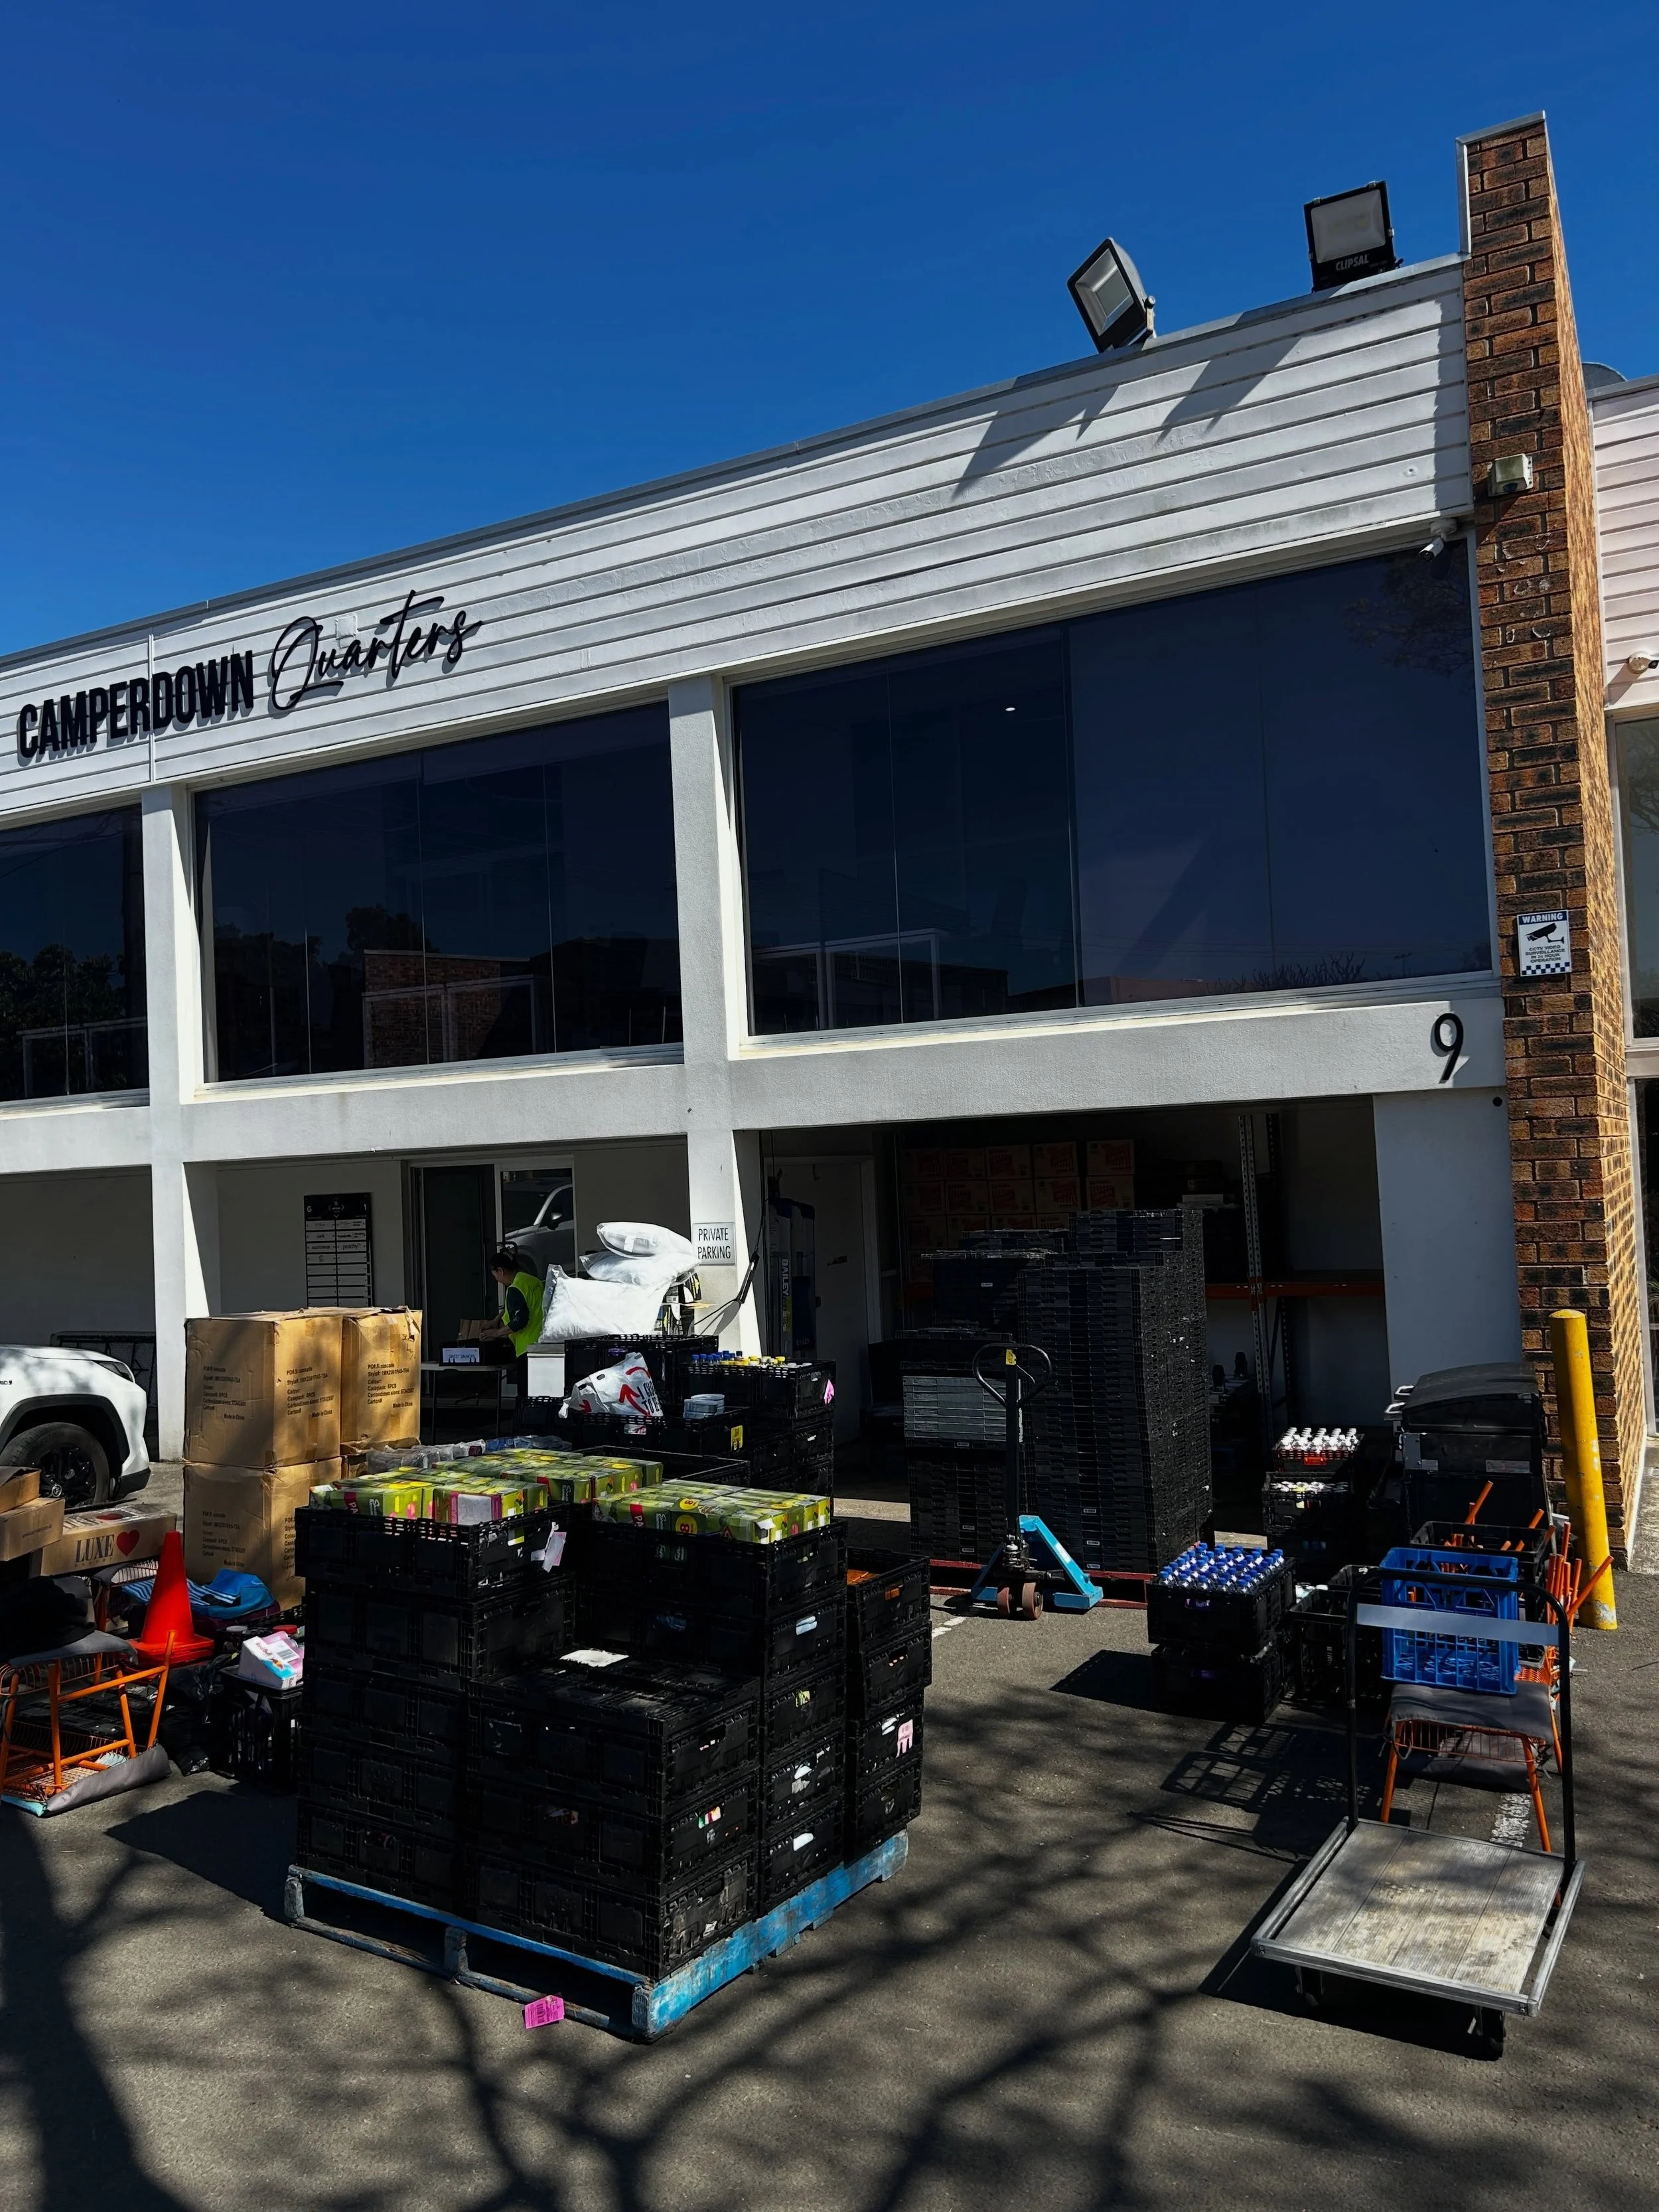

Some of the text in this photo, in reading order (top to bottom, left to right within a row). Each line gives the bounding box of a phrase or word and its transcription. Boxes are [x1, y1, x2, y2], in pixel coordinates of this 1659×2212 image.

[1335, 254, 1370, 271] CLIPSAL
[19, 589, 484, 759] CAMPERDOWN Quarters
[1522, 912, 1563, 924] WARNING
[1433, 1013, 1464, 1084] 9
[698, 1227, 729, 1242] PRIVATE
[697, 1245, 731, 1260] PARKING
[636, 1386, 645, 1400] I
[76, 1534, 115, 1563] LUXE
